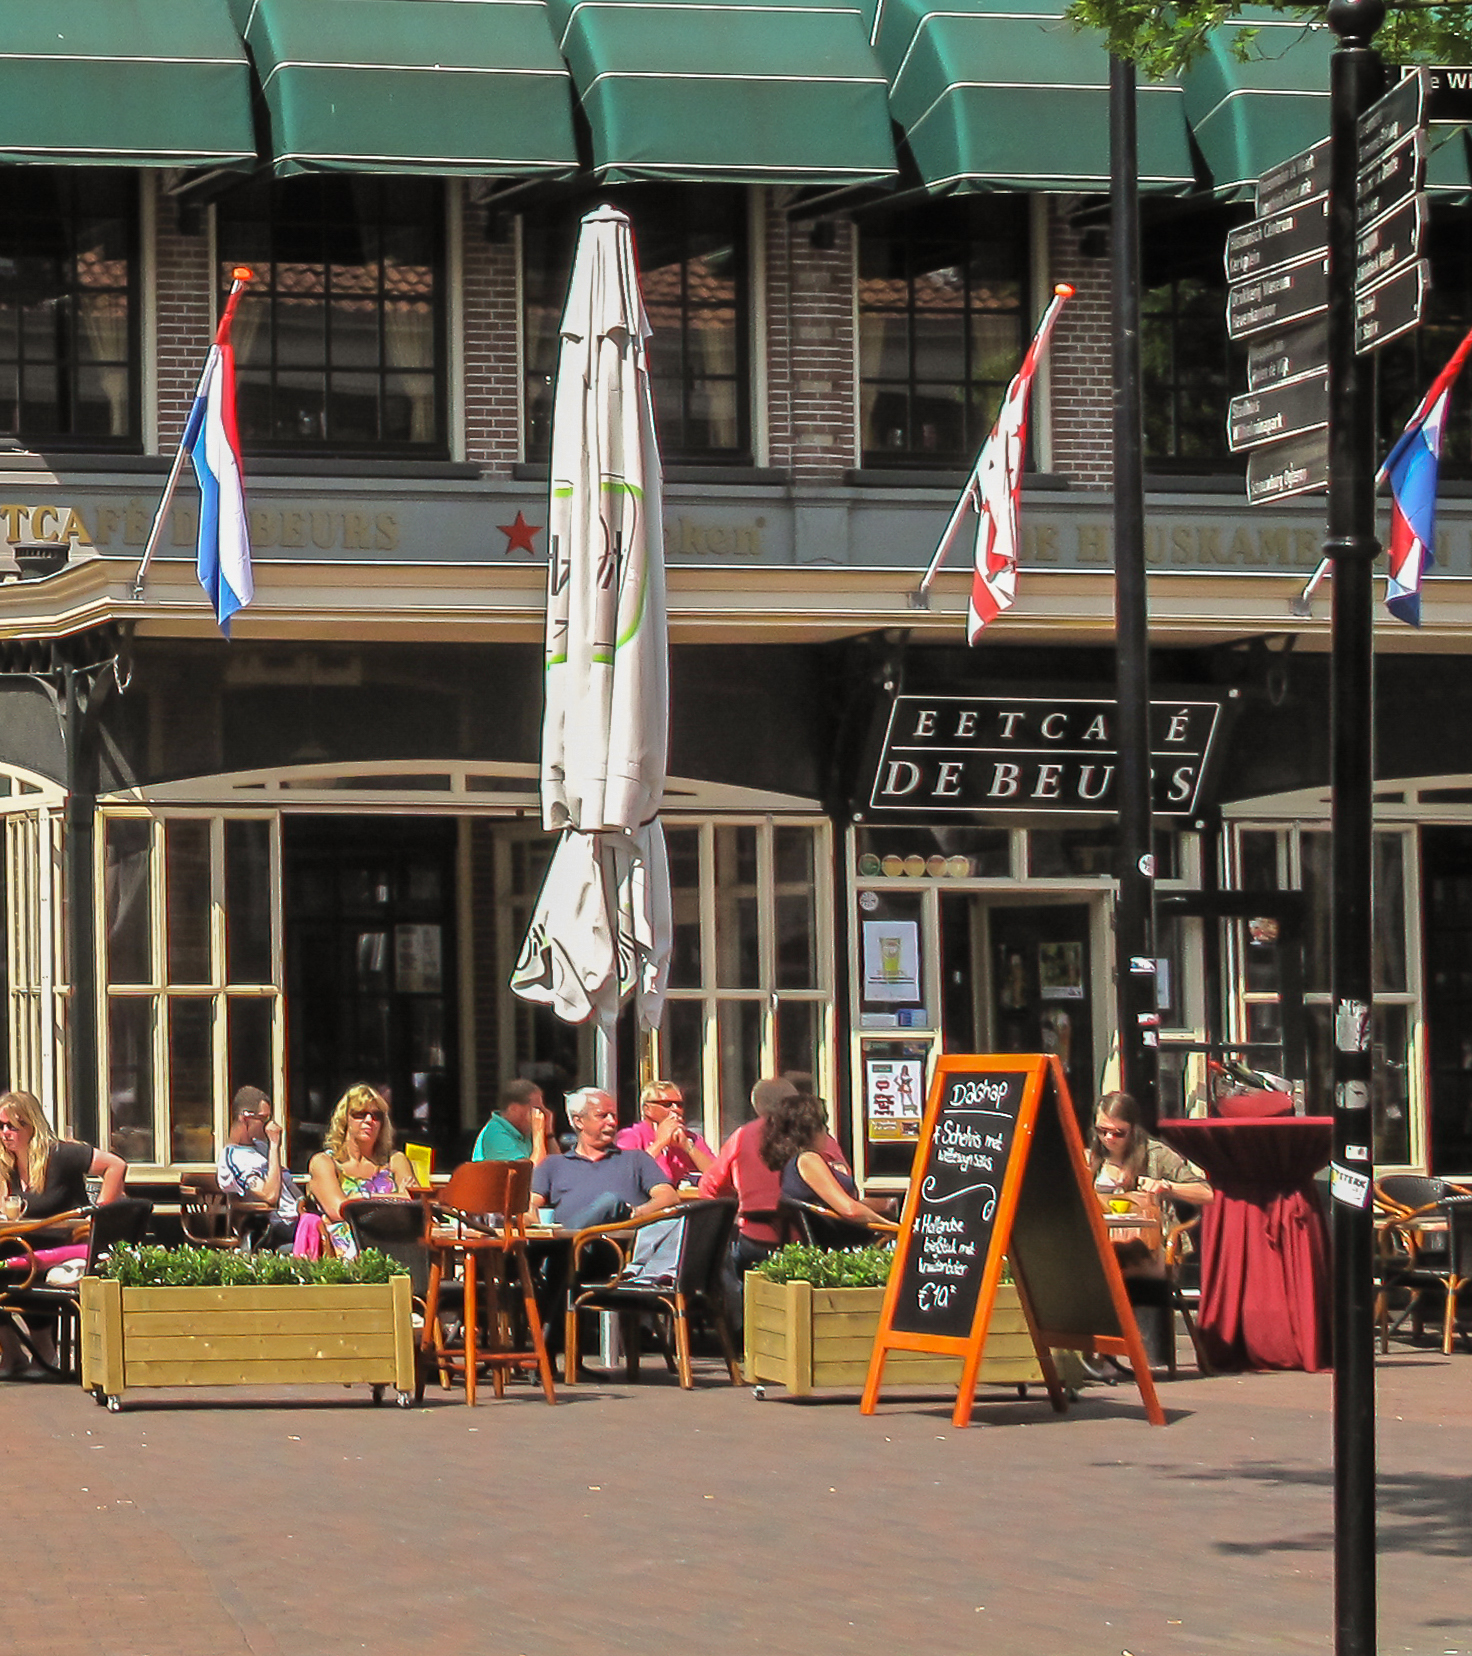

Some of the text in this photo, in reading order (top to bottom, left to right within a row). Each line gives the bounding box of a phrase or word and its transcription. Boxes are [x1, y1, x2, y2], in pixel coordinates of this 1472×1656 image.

[912, 708, 1191, 742] EETCAÉ
[881, 759, 1196, 802] DE BEUS
